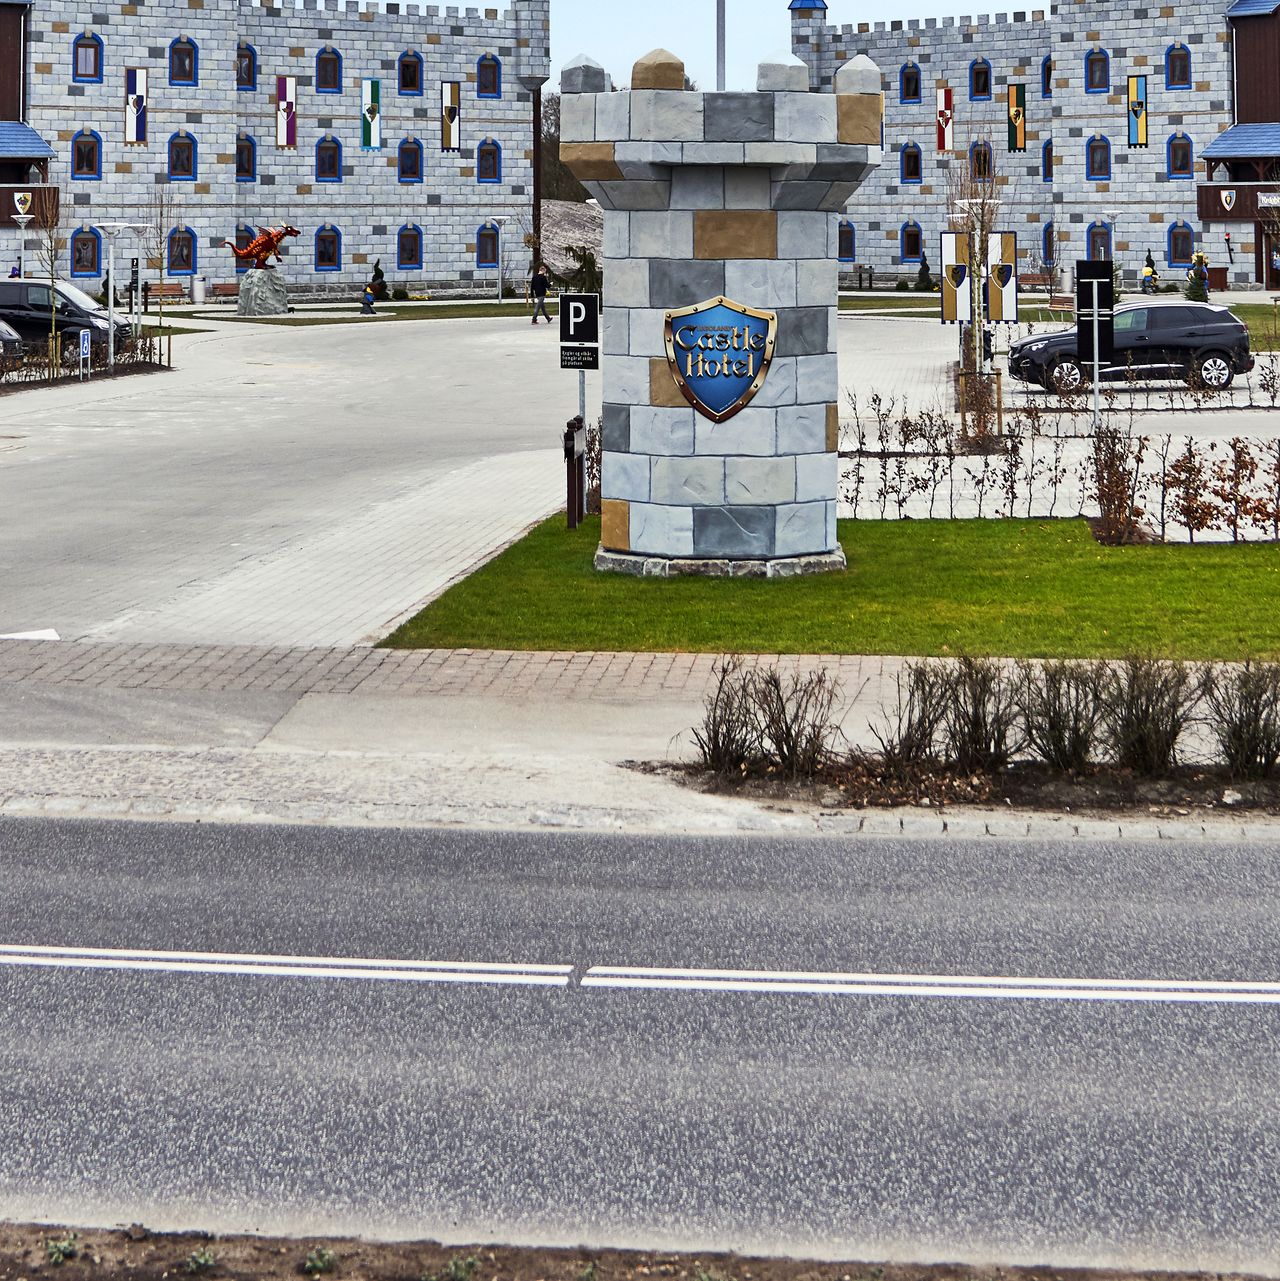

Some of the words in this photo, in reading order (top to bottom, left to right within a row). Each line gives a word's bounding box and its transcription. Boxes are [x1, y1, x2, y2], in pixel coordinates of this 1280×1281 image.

[569, 302, 586, 335] P
[675, 325, 765, 351] Castle
[685, 352, 754, 378] Hotel
